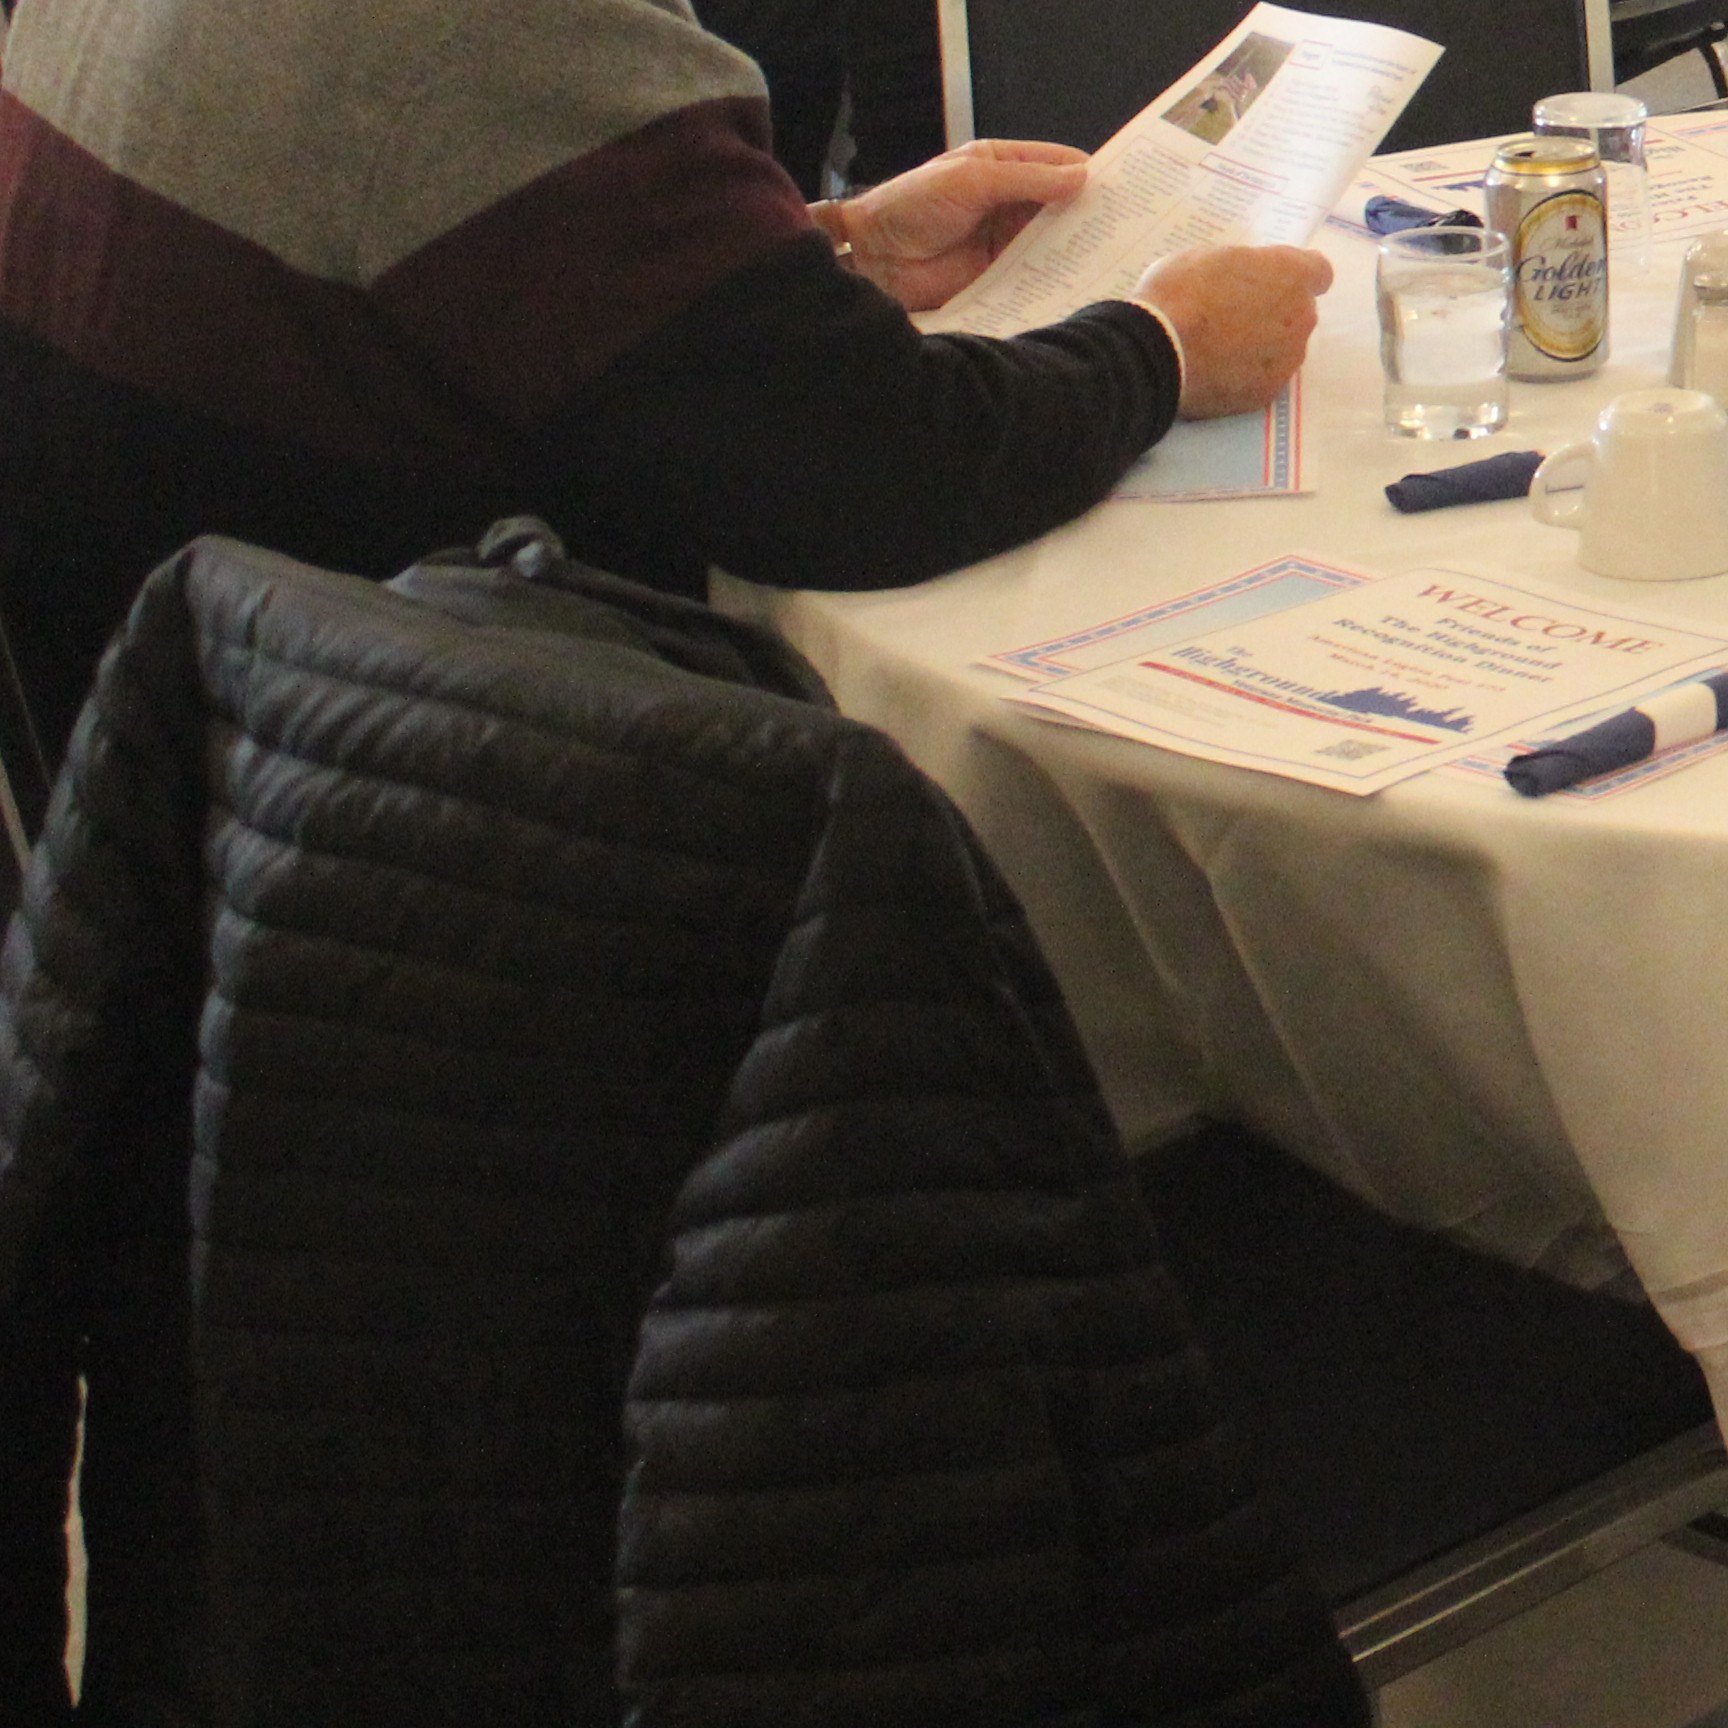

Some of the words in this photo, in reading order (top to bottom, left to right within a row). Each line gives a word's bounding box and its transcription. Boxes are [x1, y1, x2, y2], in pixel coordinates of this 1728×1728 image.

[1381, 614, 1421, 633] The
[1426, 631, 1563, 670] Highground
[1416, 584, 1665, 654] WELCOME
[1437, 617, 1521, 646] Friends
[1527, 642, 1557, 653] of
[1333, 618, 1468, 664] Recognition
[1474, 660, 1555, 683] Dinner
